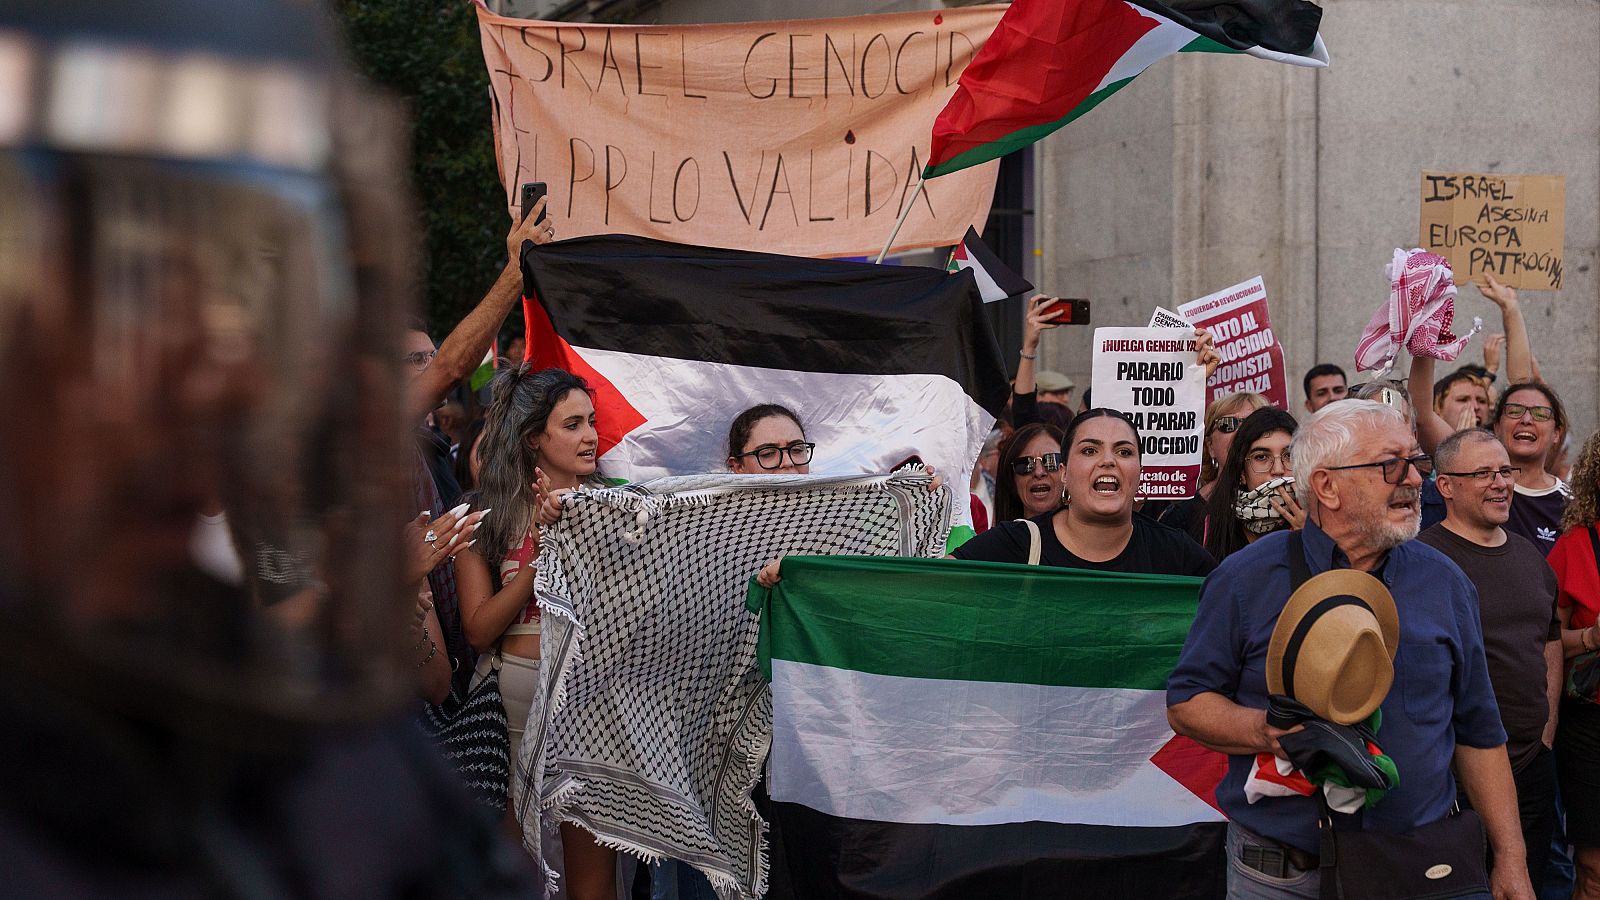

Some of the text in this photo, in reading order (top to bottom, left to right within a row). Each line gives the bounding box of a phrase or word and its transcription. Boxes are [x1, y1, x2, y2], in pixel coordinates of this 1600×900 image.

[494, 25, 977, 99] ISRAEL GENOCID
[650, 151, 701, 224] LO
[723, 138, 936, 231] VALIDA
[1425, 175, 1513, 203] ISRAEL
[1477, 203, 1549, 224] ASESINA
[1430, 223, 1521, 248] EUROPA
[1184, 284, 1262, 318] IZQUIERDA REVOLUCIONARIA
[1154, 316, 1181, 328] GENO
[1157, 311, 1185, 328] PAREMOS
[1207, 311, 1259, 344] ALTO AL
[1102, 340, 1197, 352] ¡HUELGA GENERAL YA
[1217, 328, 1274, 364] NOCIDIO
[1116, 362, 1184, 381] PARARLO
[1206, 352, 1273, 387] SIONISTA
[1131, 387, 1175, 406] TODO
[1147, 412, 1196, 431] PARAR
[1140, 469, 1187, 482] icato de
[1138, 482, 1186, 495] diantes
